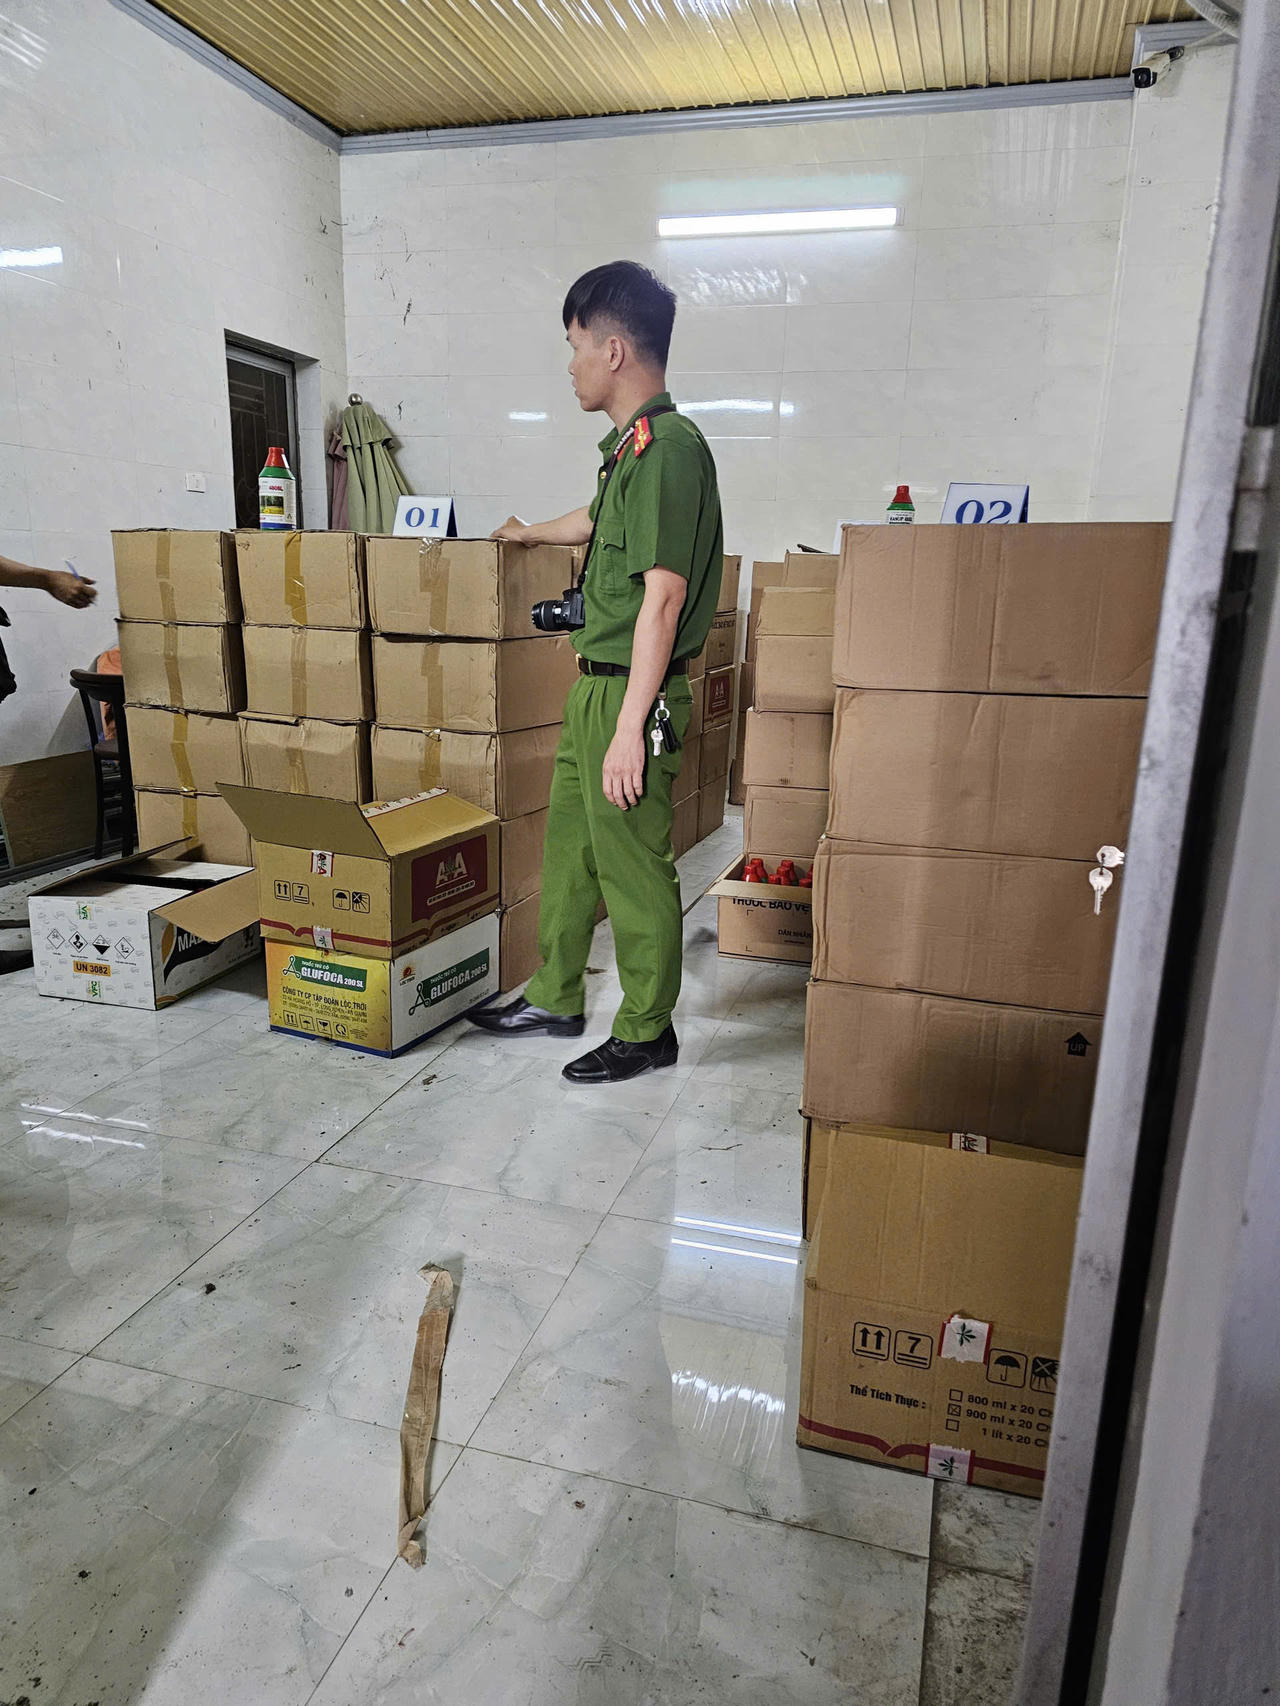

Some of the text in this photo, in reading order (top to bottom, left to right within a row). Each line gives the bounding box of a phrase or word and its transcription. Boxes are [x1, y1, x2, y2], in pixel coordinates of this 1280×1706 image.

[405, 507, 439, 528] 01
[955, 500, 1012, 524] 02
[178, 932, 203, 952] MA
[75, 963, 108, 975] UN 3082
[301, 967, 344, 985] GLUFOCA
[431, 970, 470, 1000] GLUFOCA
[908, 1336, 921, 1354] 7
[849, 1384, 868, 1397] Thể
[870, 1388, 892, 1402] Tích
[895, 1393, 919, 1409] Thực
[967, 1394, 988, 1406] 800
[992, 1400, 1007, 1410] ml
[1020, 1404, 1035, 1415] 20
[966, 1408, 987, 1420] 900
[990, 1415, 1005, 1424] ml
[1008, 1418, 1015, 1426] x
[1018, 1419, 1033, 1430] 20
[982, 1427, 987, 1436] 1
[1006, 1434, 1013, 1442] x
[1016, 1434, 1031, 1445] 20
